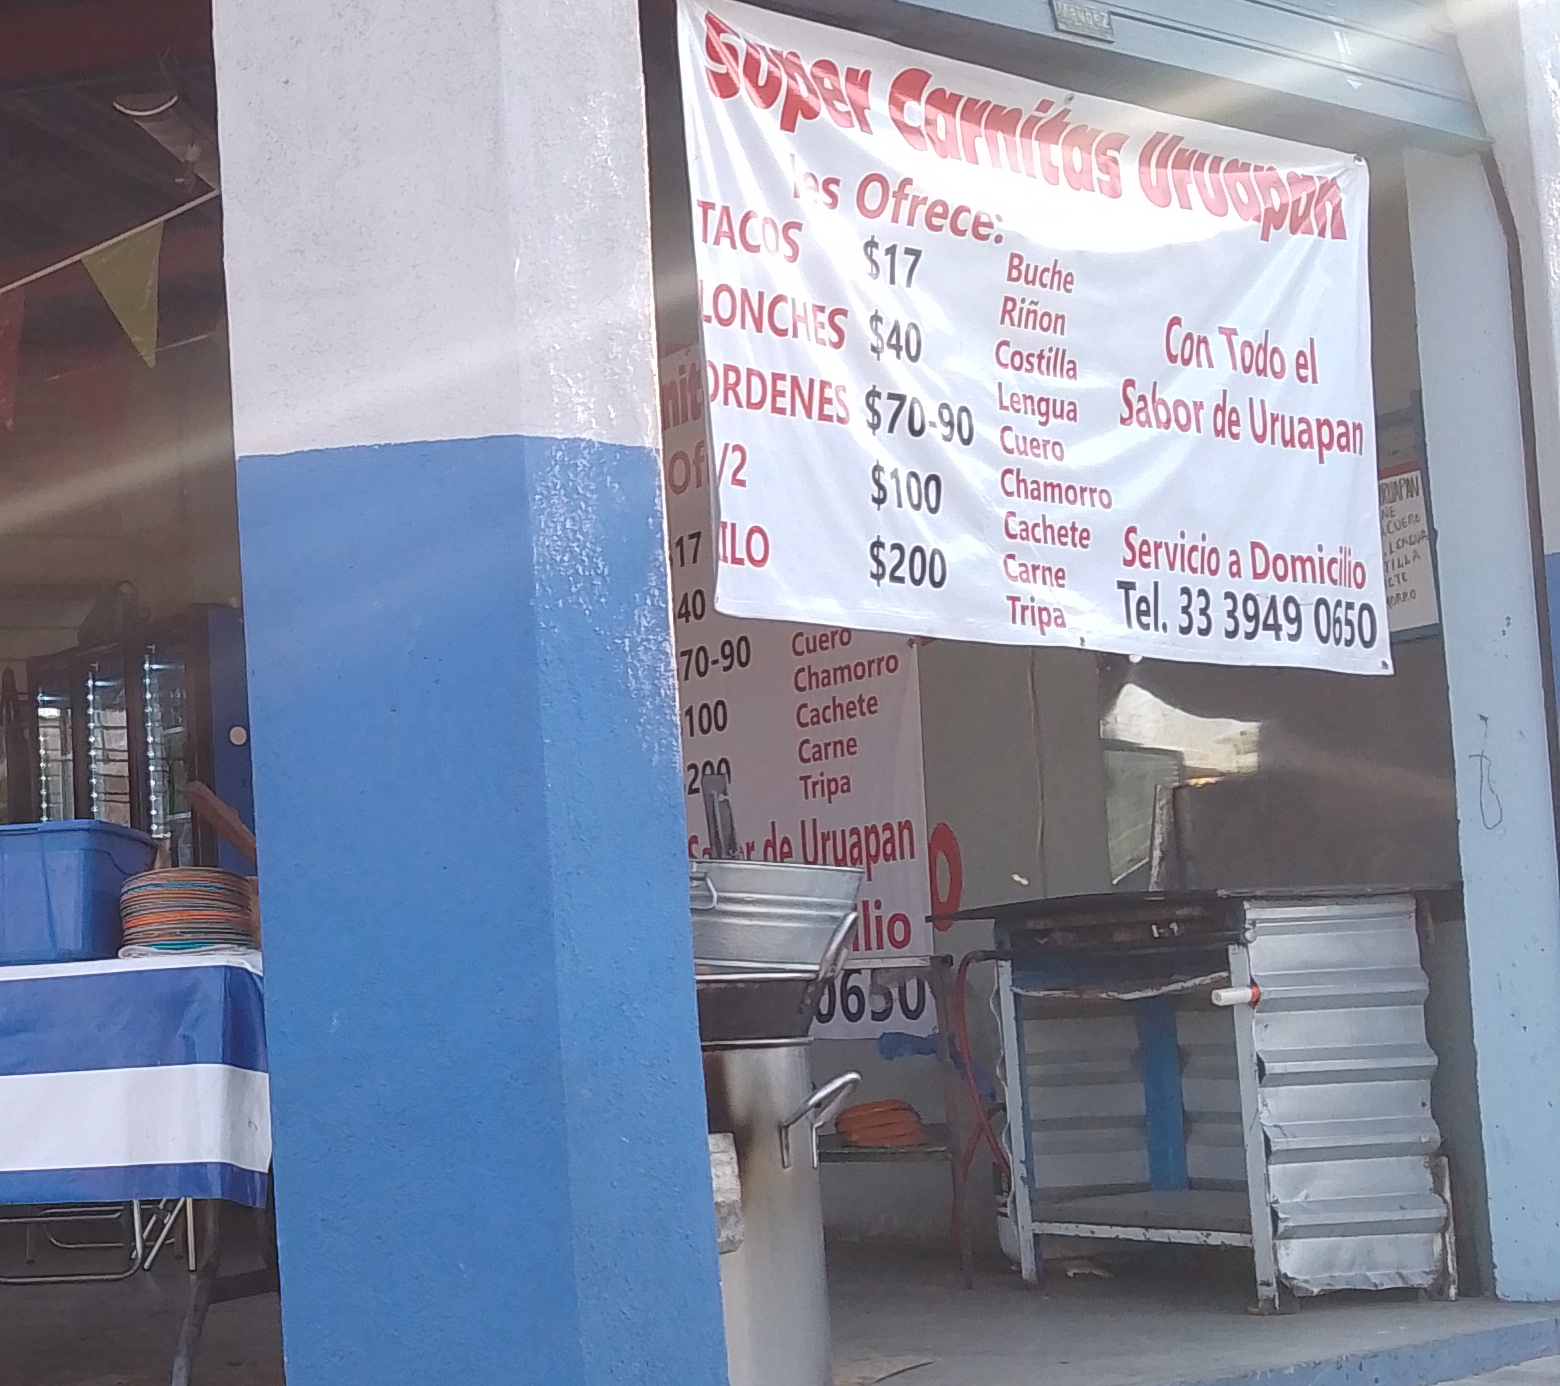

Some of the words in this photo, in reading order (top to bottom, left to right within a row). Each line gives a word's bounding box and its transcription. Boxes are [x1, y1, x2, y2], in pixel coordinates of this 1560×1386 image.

[704, 10, 873, 134] Super
[888, 66, 1131, 200] Carnitas
[1138, 131, 1348, 242] Uruapan
[789, 153, 841, 210] les
[856, 172, 1004, 245] Ofrece:
[696, 199, 804, 264] TACOS
[862, 234, 923, 289] $17
[1005, 251, 1075, 294] Buche
[699, 279, 849, 350] LONCHES
[869, 308, 922, 364] $40
[999, 295, 1066, 337] Riñon
[994, 339, 1078, 381] Costilla
[1164, 315, 1215, 369] Con
[1217, 325, 1287, 380] Todo
[1294, 336, 1319, 385] el
[864, 384, 975, 447] $70-90
[997, 381, 1078, 427] Lengua
[1119, 377, 1205, 434] Sabor
[1212, 388, 1242, 441] de
[1248, 396, 1364, 465] Uruapan
[999, 425, 1065, 462] Cuero
[870, 458, 942, 515] $100
[1000, 467, 1113, 510] Chamorro
[674, 530, 702, 568] 17
[1004, 510, 1091, 550] Cachete
[869, 534, 947, 589] $200
[1003, 553, 1066, 589] Carne
[1122, 525, 1221, 577] Servicio
[1227, 548, 1243, 579] a
[1249, 539, 1367, 590] Domicilio
[676, 587, 707, 625] 40
[1005, 594, 1067, 636] Tripa
[1115, 579, 1168, 634] Tel.
[1177, 585, 1213, 637] 33
[1223, 590, 1303, 643] 3949
[1313, 596, 1378, 650] 0650
[679, 634, 752, 682] 70-90
[791, 627, 853, 657] Cuero
[793, 653, 900, 693] Chamorro
[683, 699, 729, 738] 100
[796, 693, 879, 729] Cachete
[798, 736, 858, 765] Carne
[799, 770, 852, 805] Tripa
[800, 818, 916, 882] Uruapan
